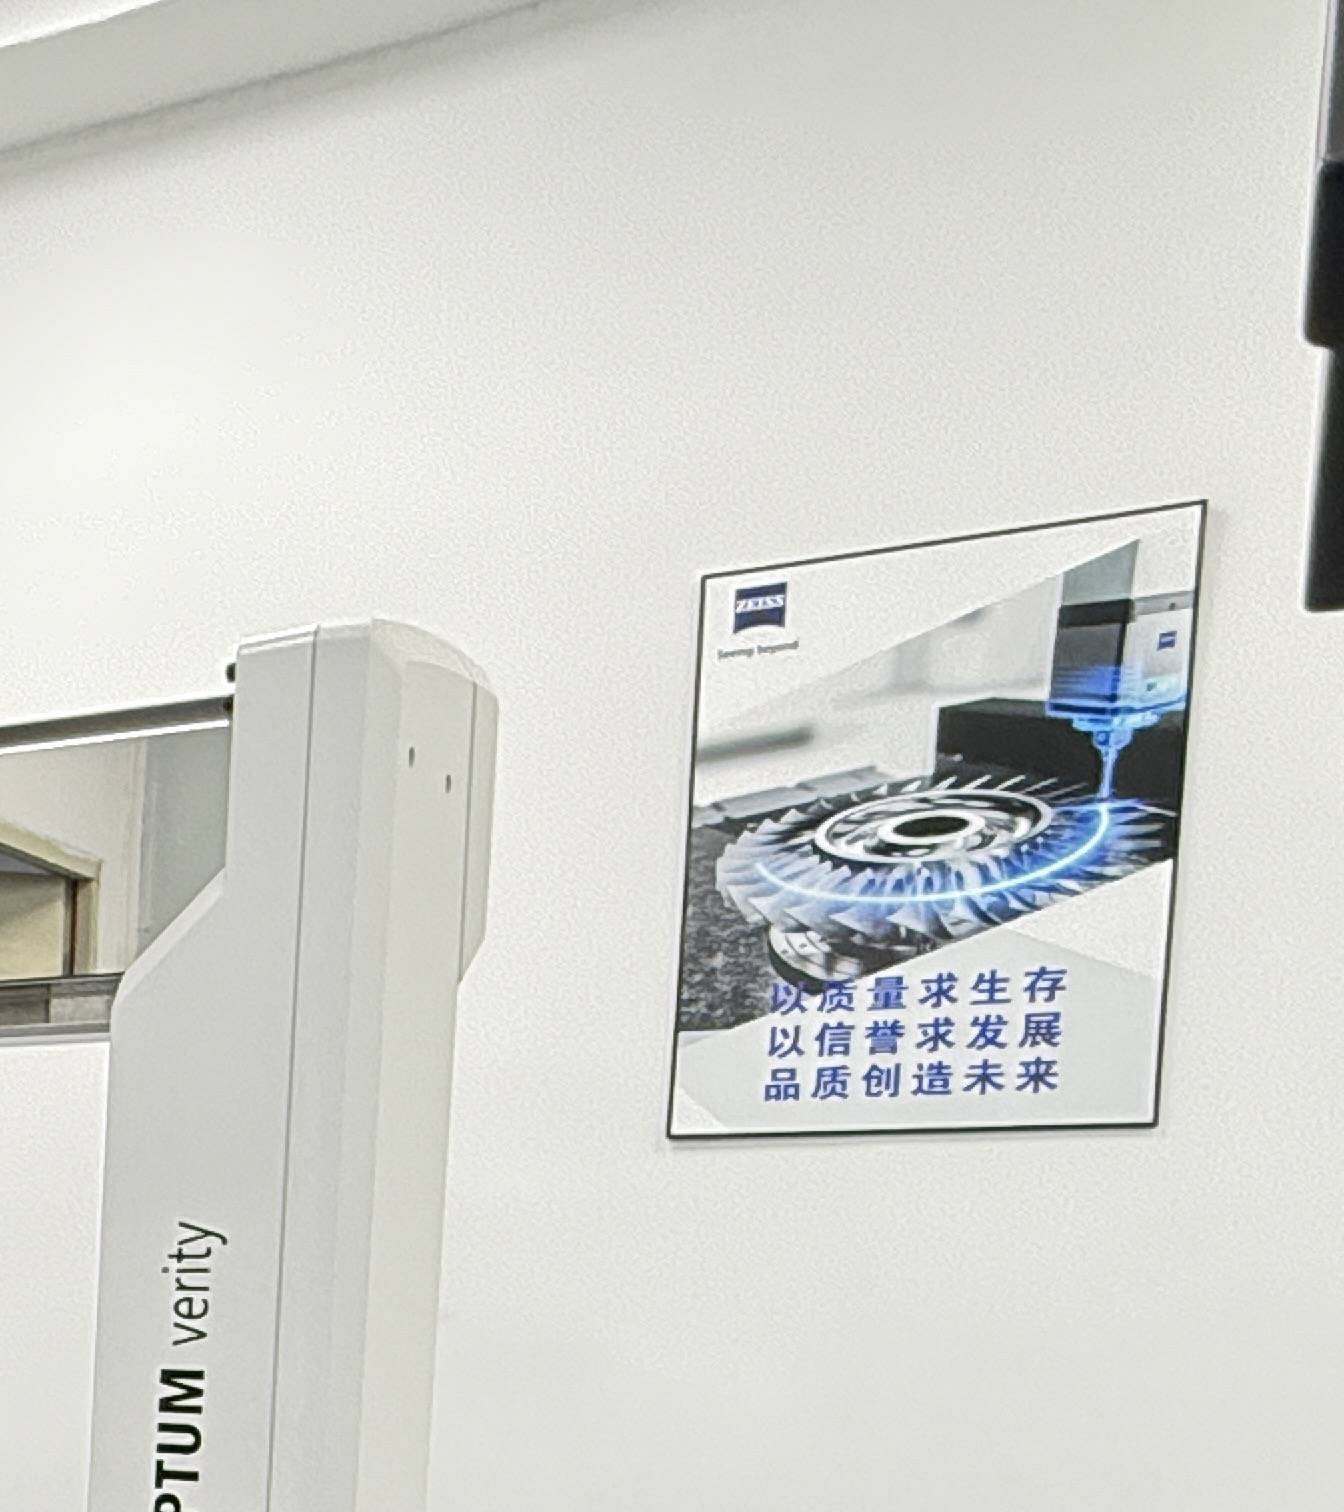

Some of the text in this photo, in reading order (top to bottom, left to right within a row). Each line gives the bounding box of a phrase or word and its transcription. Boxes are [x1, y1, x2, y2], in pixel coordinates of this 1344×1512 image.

[768, 965, 1069, 1016] 以质量求生存
[767, 1010, 1063, 1059] 以信誉求发展
[763, 1055, 1060, 1102] 品质创造未来
[161, 1221, 228, 1346] verity
